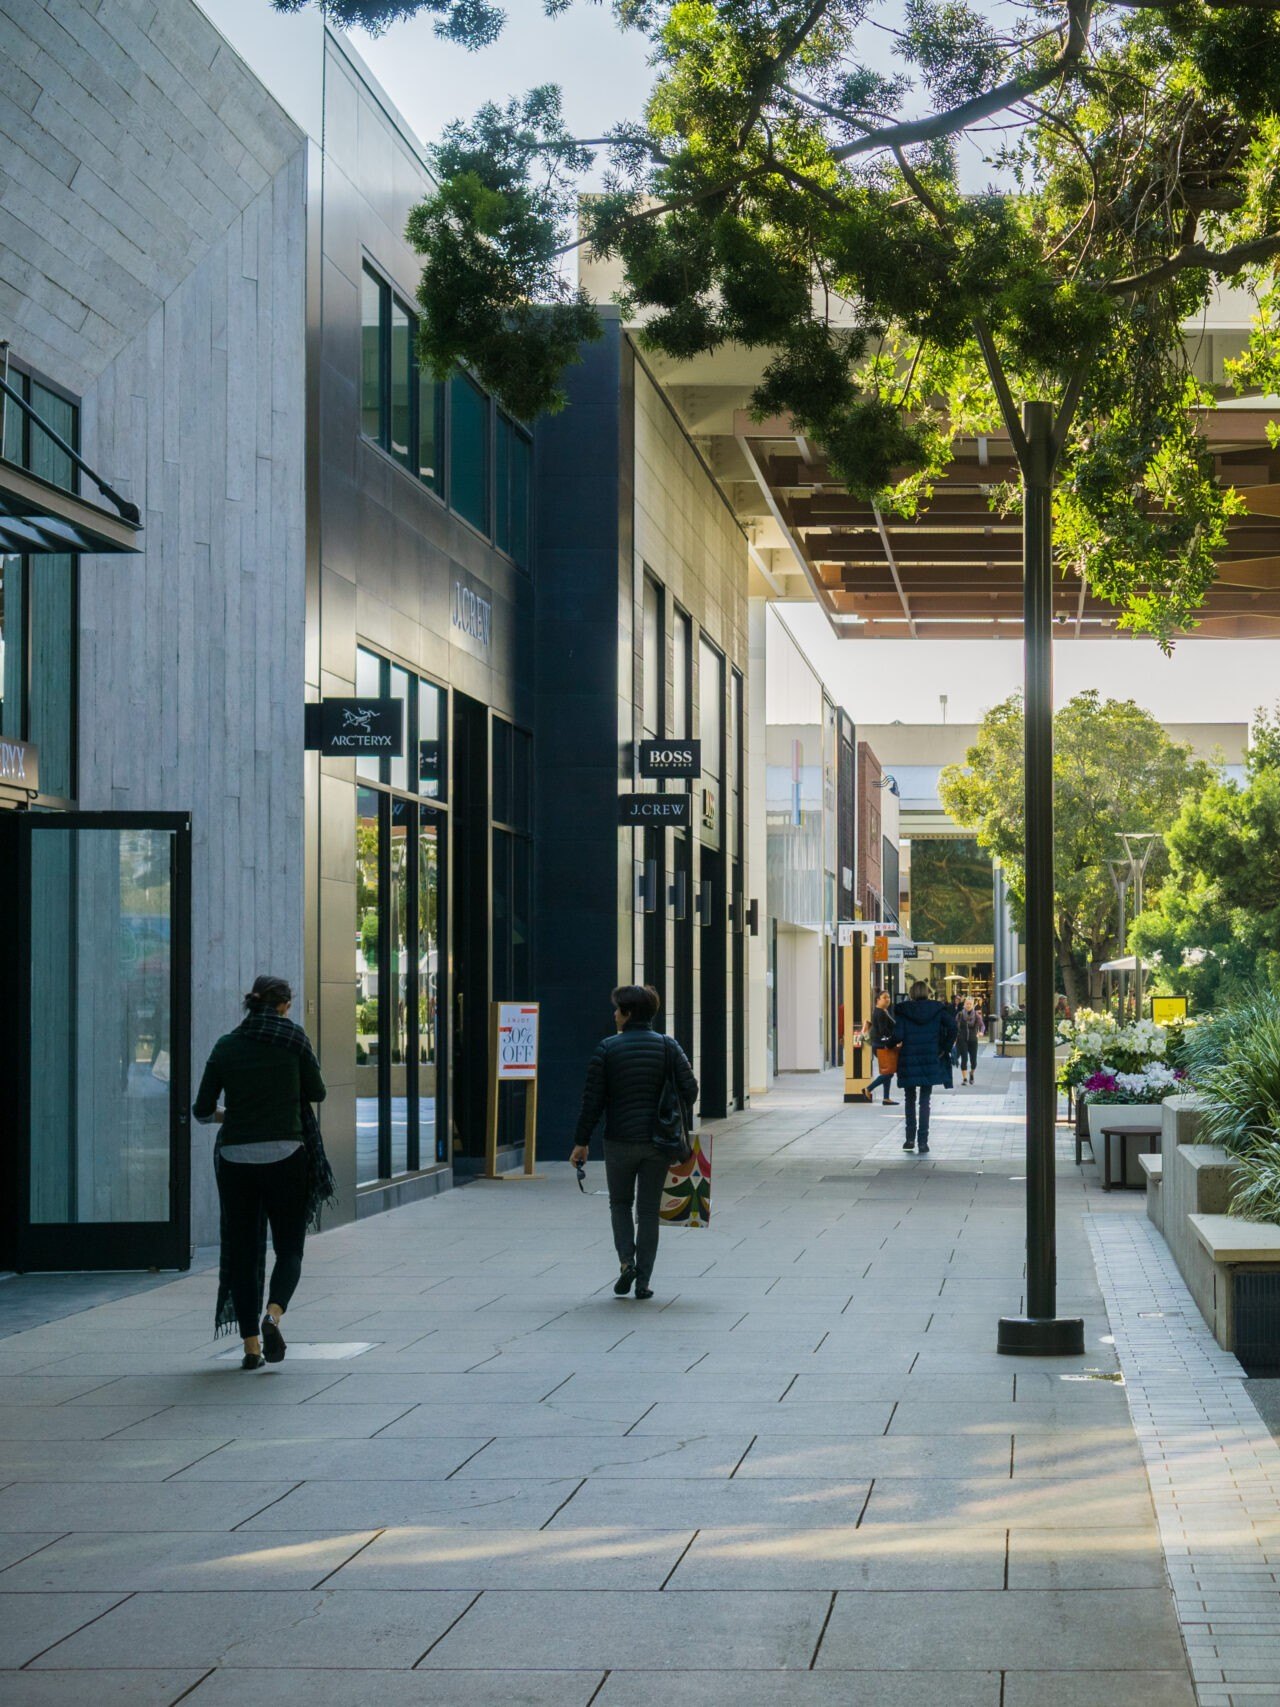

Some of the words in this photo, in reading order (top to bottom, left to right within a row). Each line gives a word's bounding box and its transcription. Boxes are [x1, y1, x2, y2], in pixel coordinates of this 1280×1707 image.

[453, 581, 491, 648] J.CREW
[649, 750, 693, 764] BOSS
[630, 804, 685, 816] J.CREW
[503, 1027, 532, 1044] 30%
[502, 1045, 534, 1063] OFF
